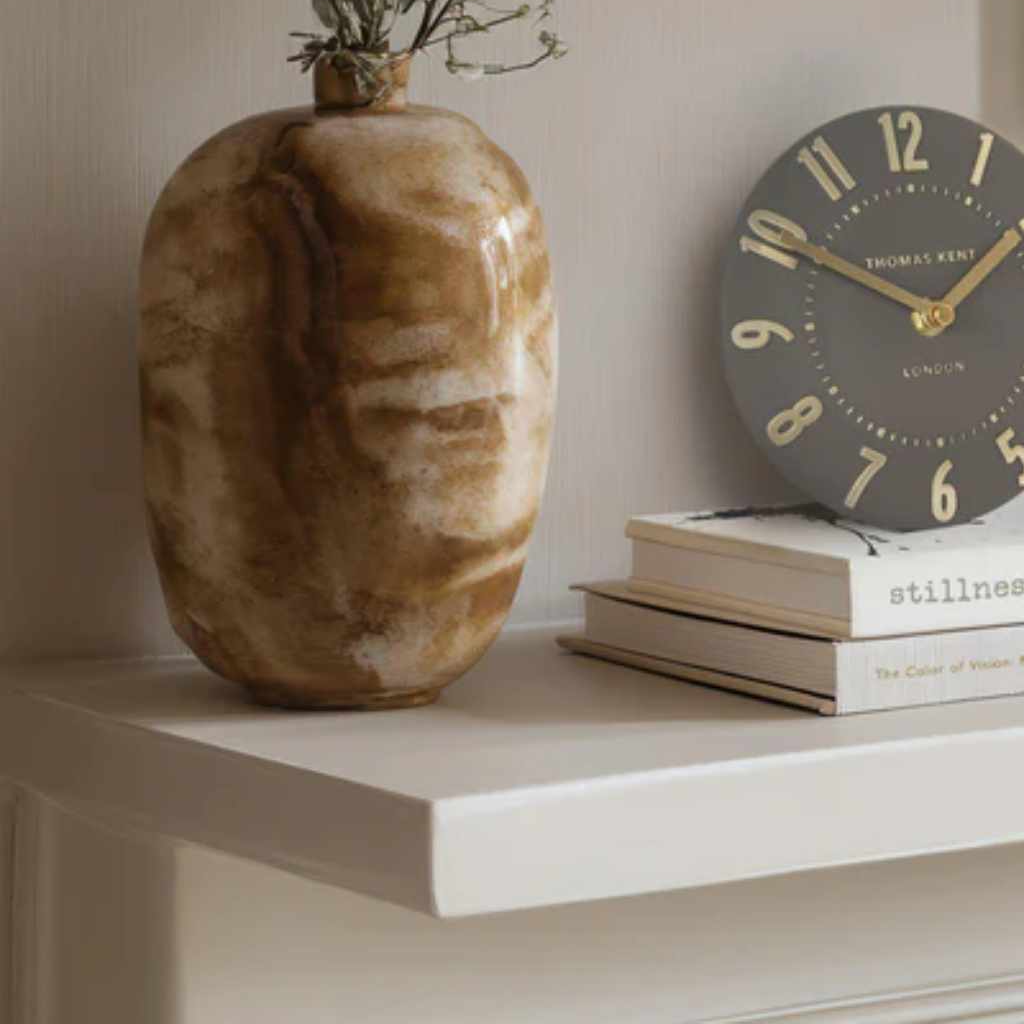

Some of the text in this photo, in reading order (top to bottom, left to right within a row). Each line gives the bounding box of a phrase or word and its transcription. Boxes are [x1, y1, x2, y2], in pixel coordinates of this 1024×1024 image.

[878, 110, 929, 172] 12
[969, 132, 995, 185] 1
[797, 135, 857, 202] 11
[739, 209, 808, 269] 10
[865, 248, 976, 270] THOMAS KENT
[731, 319, 795, 350] 9
[902, 361, 966, 379] LONDON
[767, 395, 823, 446] 8
[844, 447, 888, 509] 7
[931, 459, 958, 523] 6
[876, 667, 899, 678] The
[904, 665, 944, 677] Color
[949, 660, 965, 673] of
